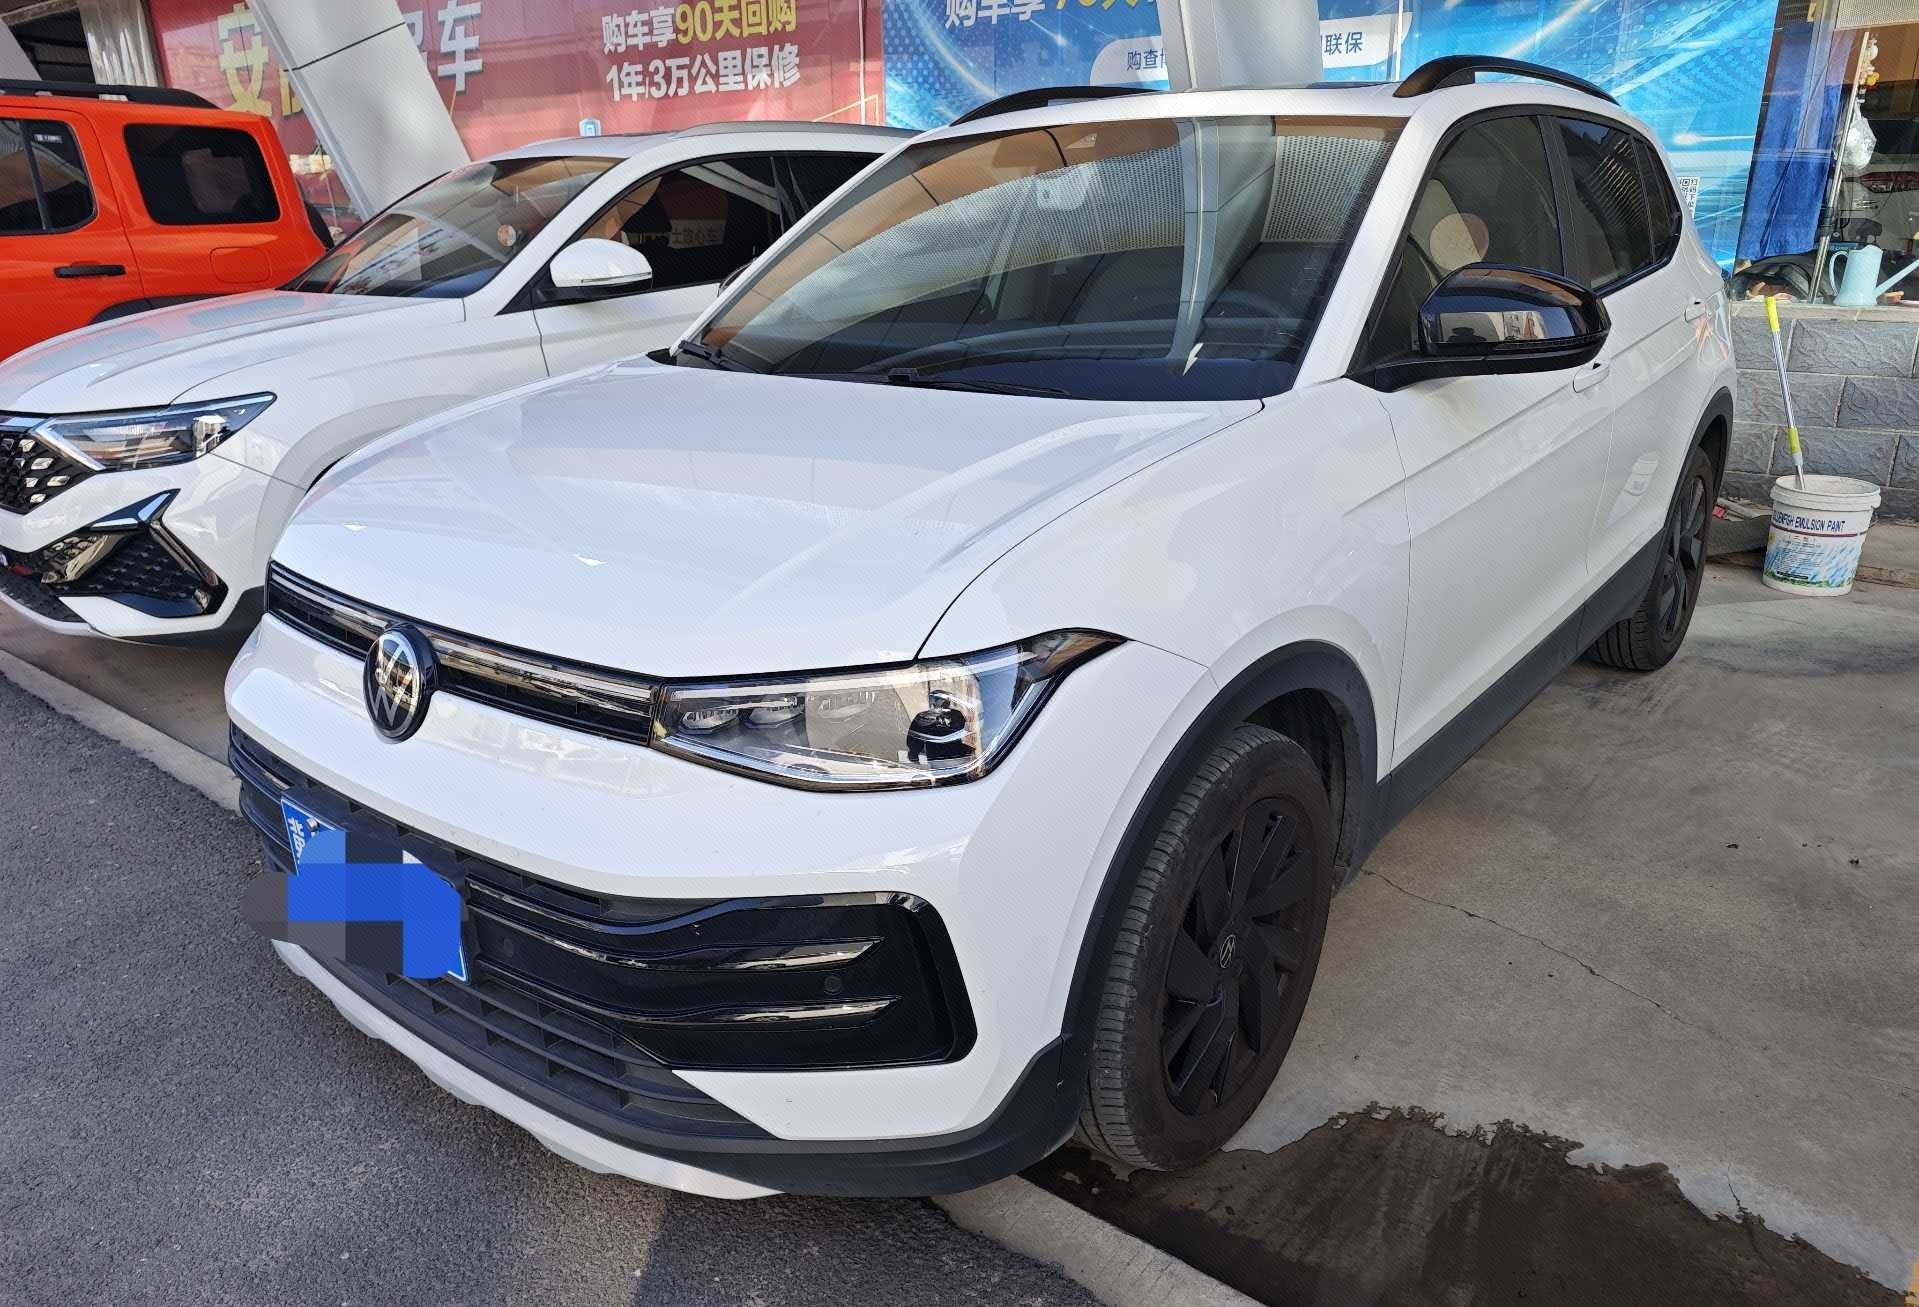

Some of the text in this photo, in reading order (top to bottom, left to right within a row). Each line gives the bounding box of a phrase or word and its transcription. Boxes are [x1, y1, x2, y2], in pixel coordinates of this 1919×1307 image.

[602, 0, 797, 55] 购车享90天回购
[1320, 31, 1363, 55] 联保
[1827, 520, 1846, 533] PAINT
